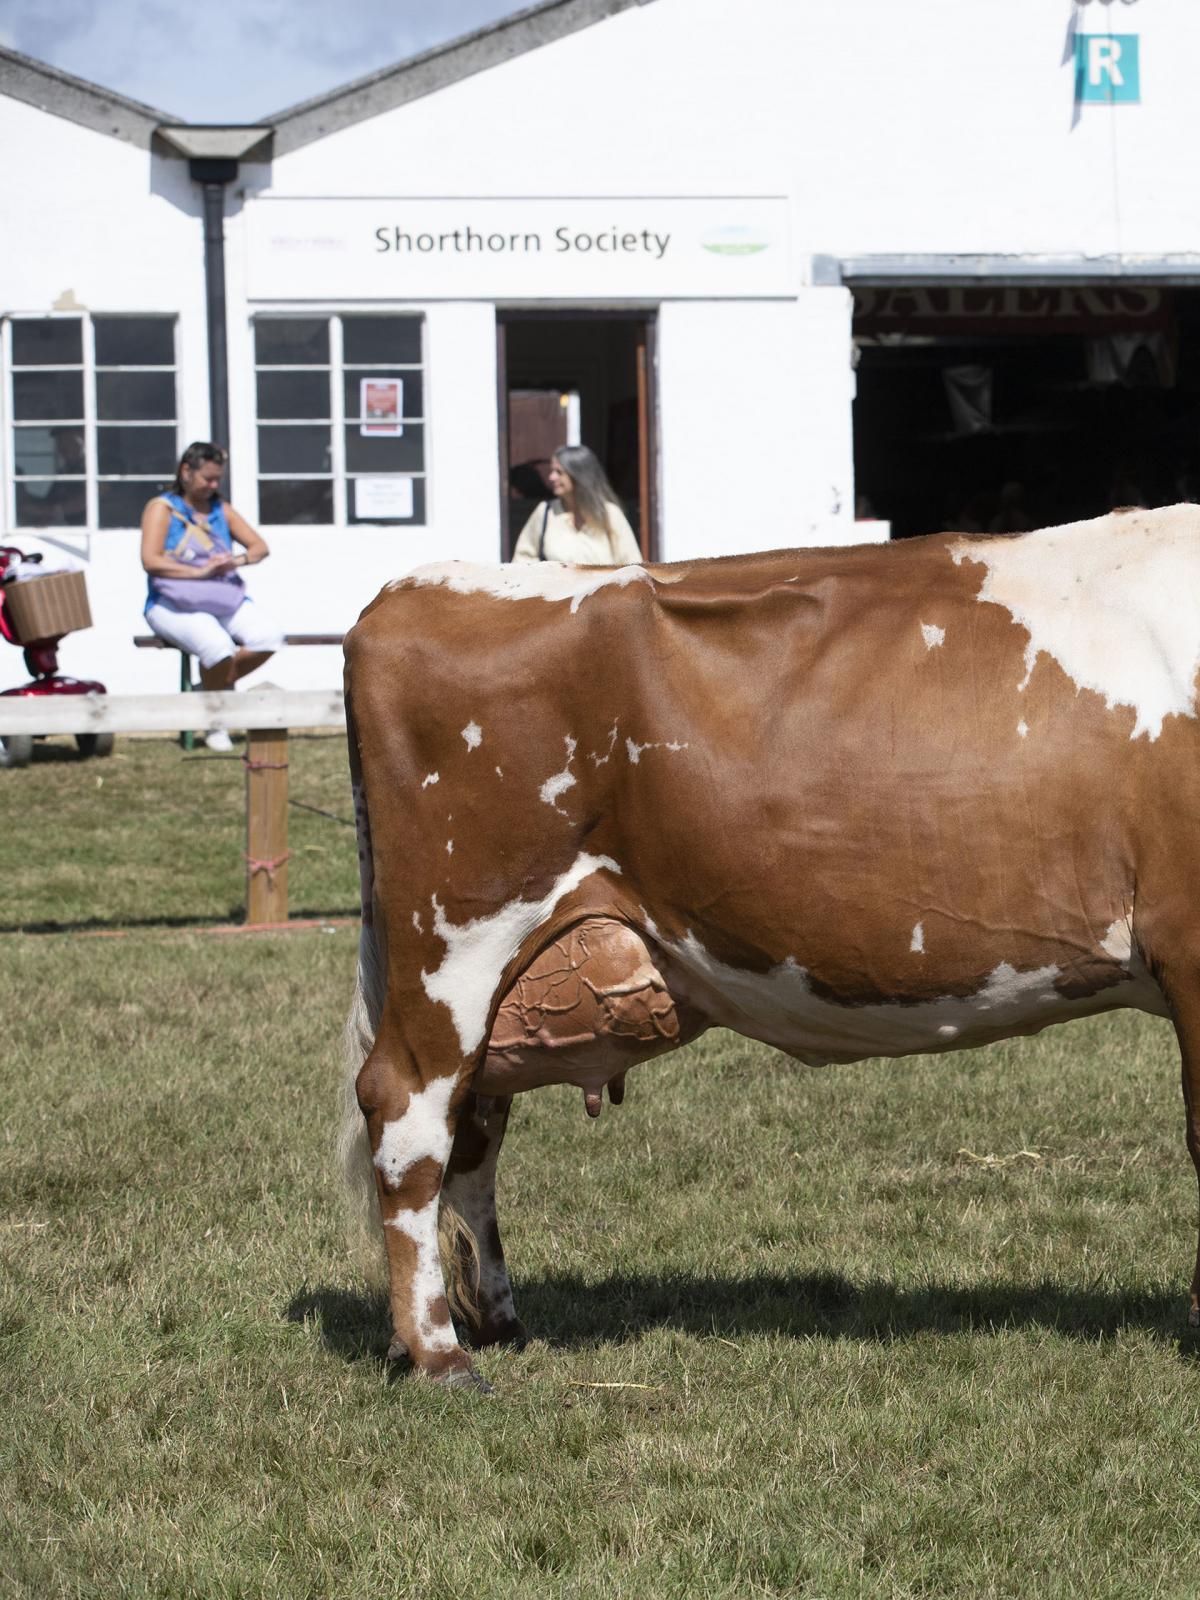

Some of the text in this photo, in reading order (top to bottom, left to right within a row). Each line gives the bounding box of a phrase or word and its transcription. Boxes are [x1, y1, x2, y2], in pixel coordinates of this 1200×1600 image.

[1089, 39, 1124, 85] R
[375, 226, 541, 252] Shorthorn
[555, 226, 671, 260] Society
[856, 286, 1161, 318] ALERS
